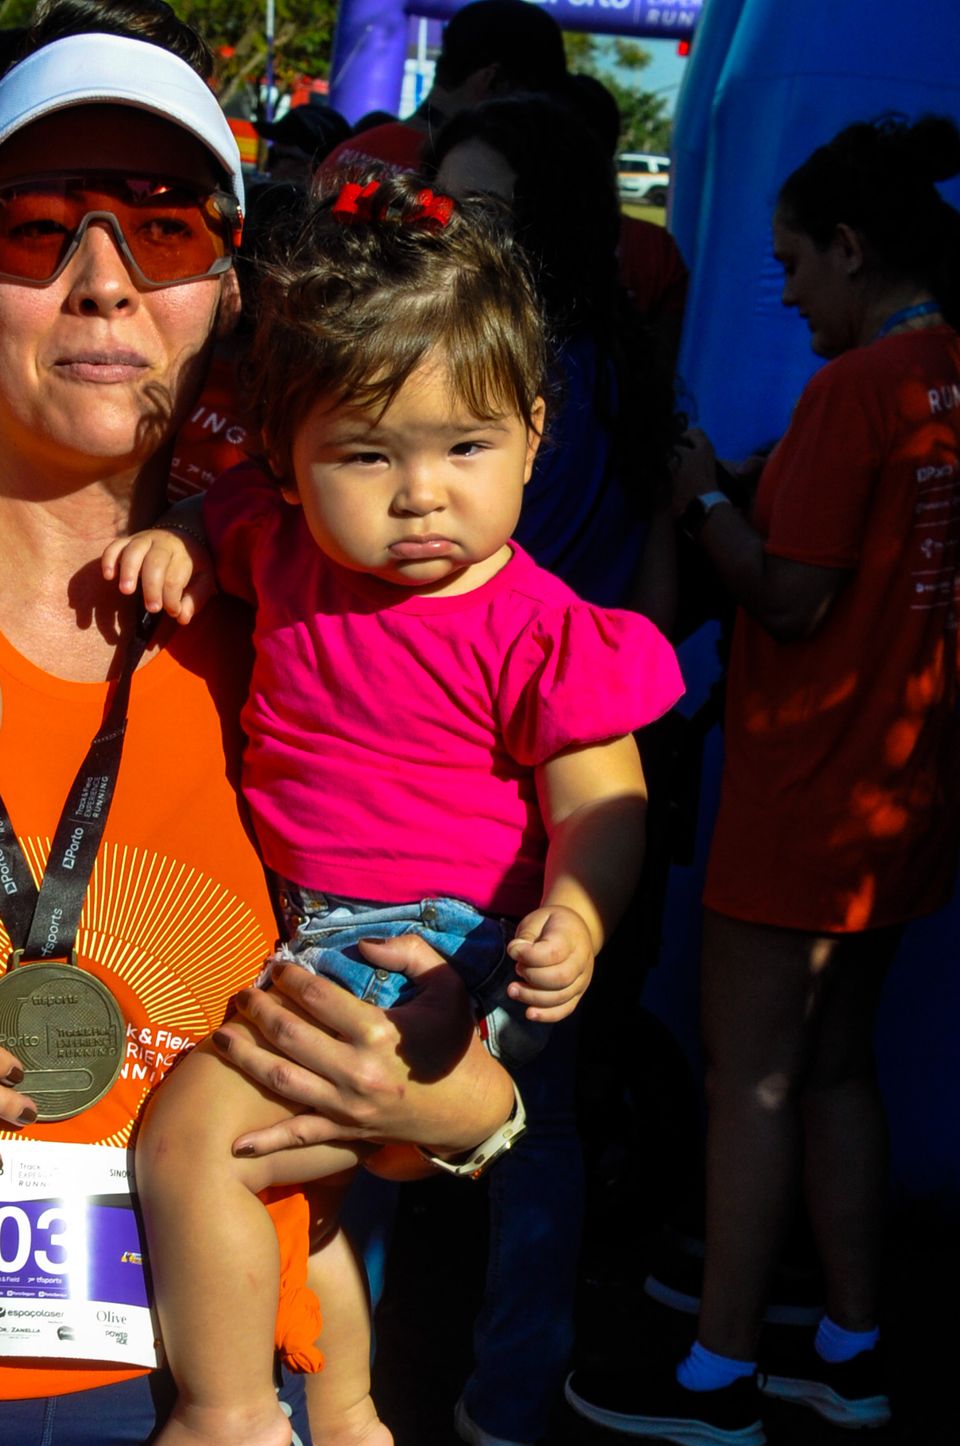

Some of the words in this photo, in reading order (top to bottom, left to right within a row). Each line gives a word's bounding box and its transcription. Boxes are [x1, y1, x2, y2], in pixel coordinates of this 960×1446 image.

[92, 775, 110, 818] RUNNING
[64, 826, 85, 859] Porto
[95, 1310, 127, 1325] Olive
